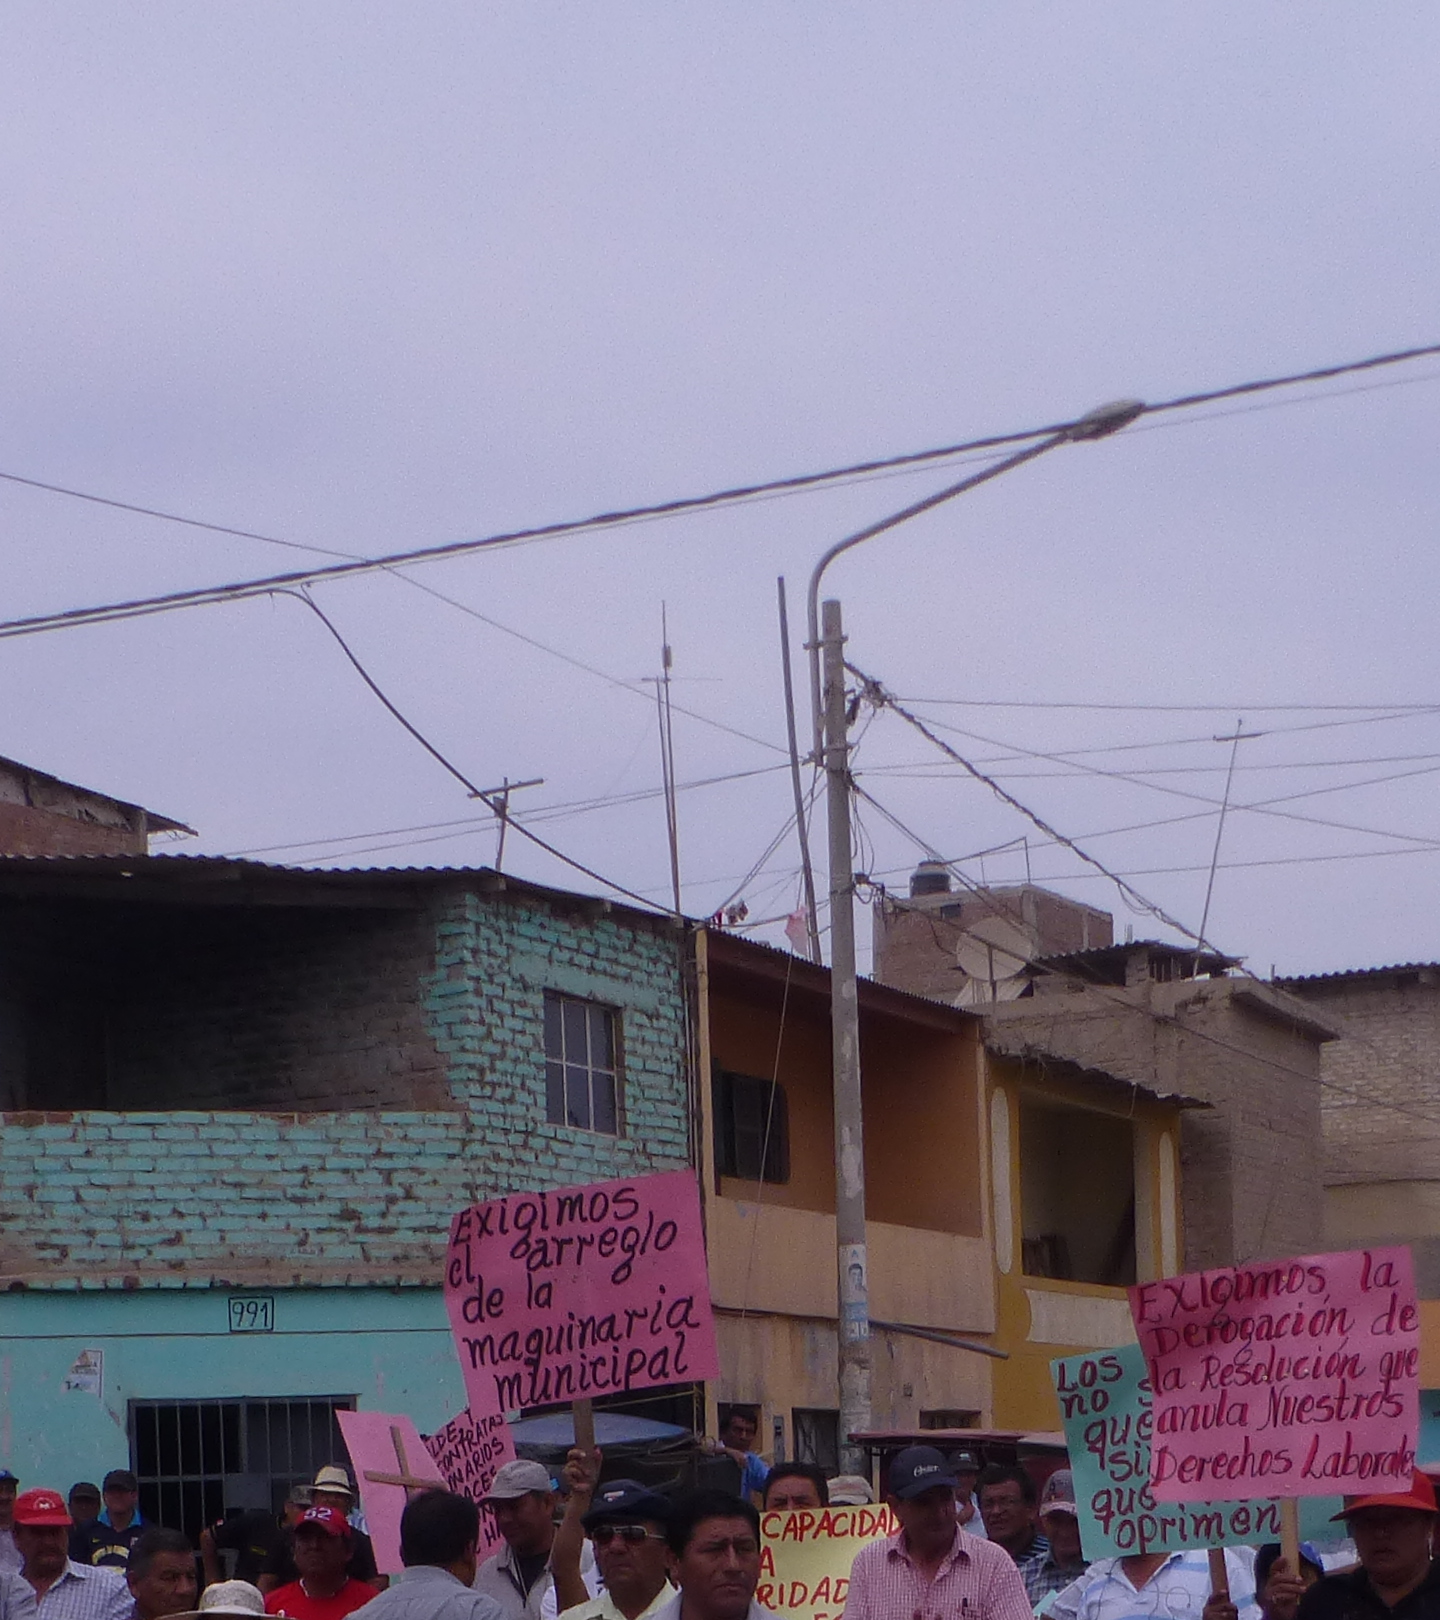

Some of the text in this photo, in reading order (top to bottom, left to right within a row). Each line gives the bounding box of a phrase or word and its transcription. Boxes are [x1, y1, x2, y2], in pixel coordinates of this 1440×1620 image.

[448, 1210, 678, 1289] el arreglo
[1360, 1251, 1398, 1294] la
[232, 1301, 269, 1328] 991
[461, 1273, 553, 1324] de la
[1370, 1292, 1418, 1334] de
[463, 1286, 701, 1375] maquinaria
[494, 1332, 688, 1413] municipal
[1057, 1355, 1123, 1393] LOS
[1150, 1357, 1184, 1397] la
[1060, 1389, 1109, 1419] no
[1157, 1388, 1249, 1433] anula
[1257, 1380, 1403, 1432] Nuestros
[1150, 1436, 1292, 1488] Derechos
[1115, 1503, 1280, 1554] oprimen
